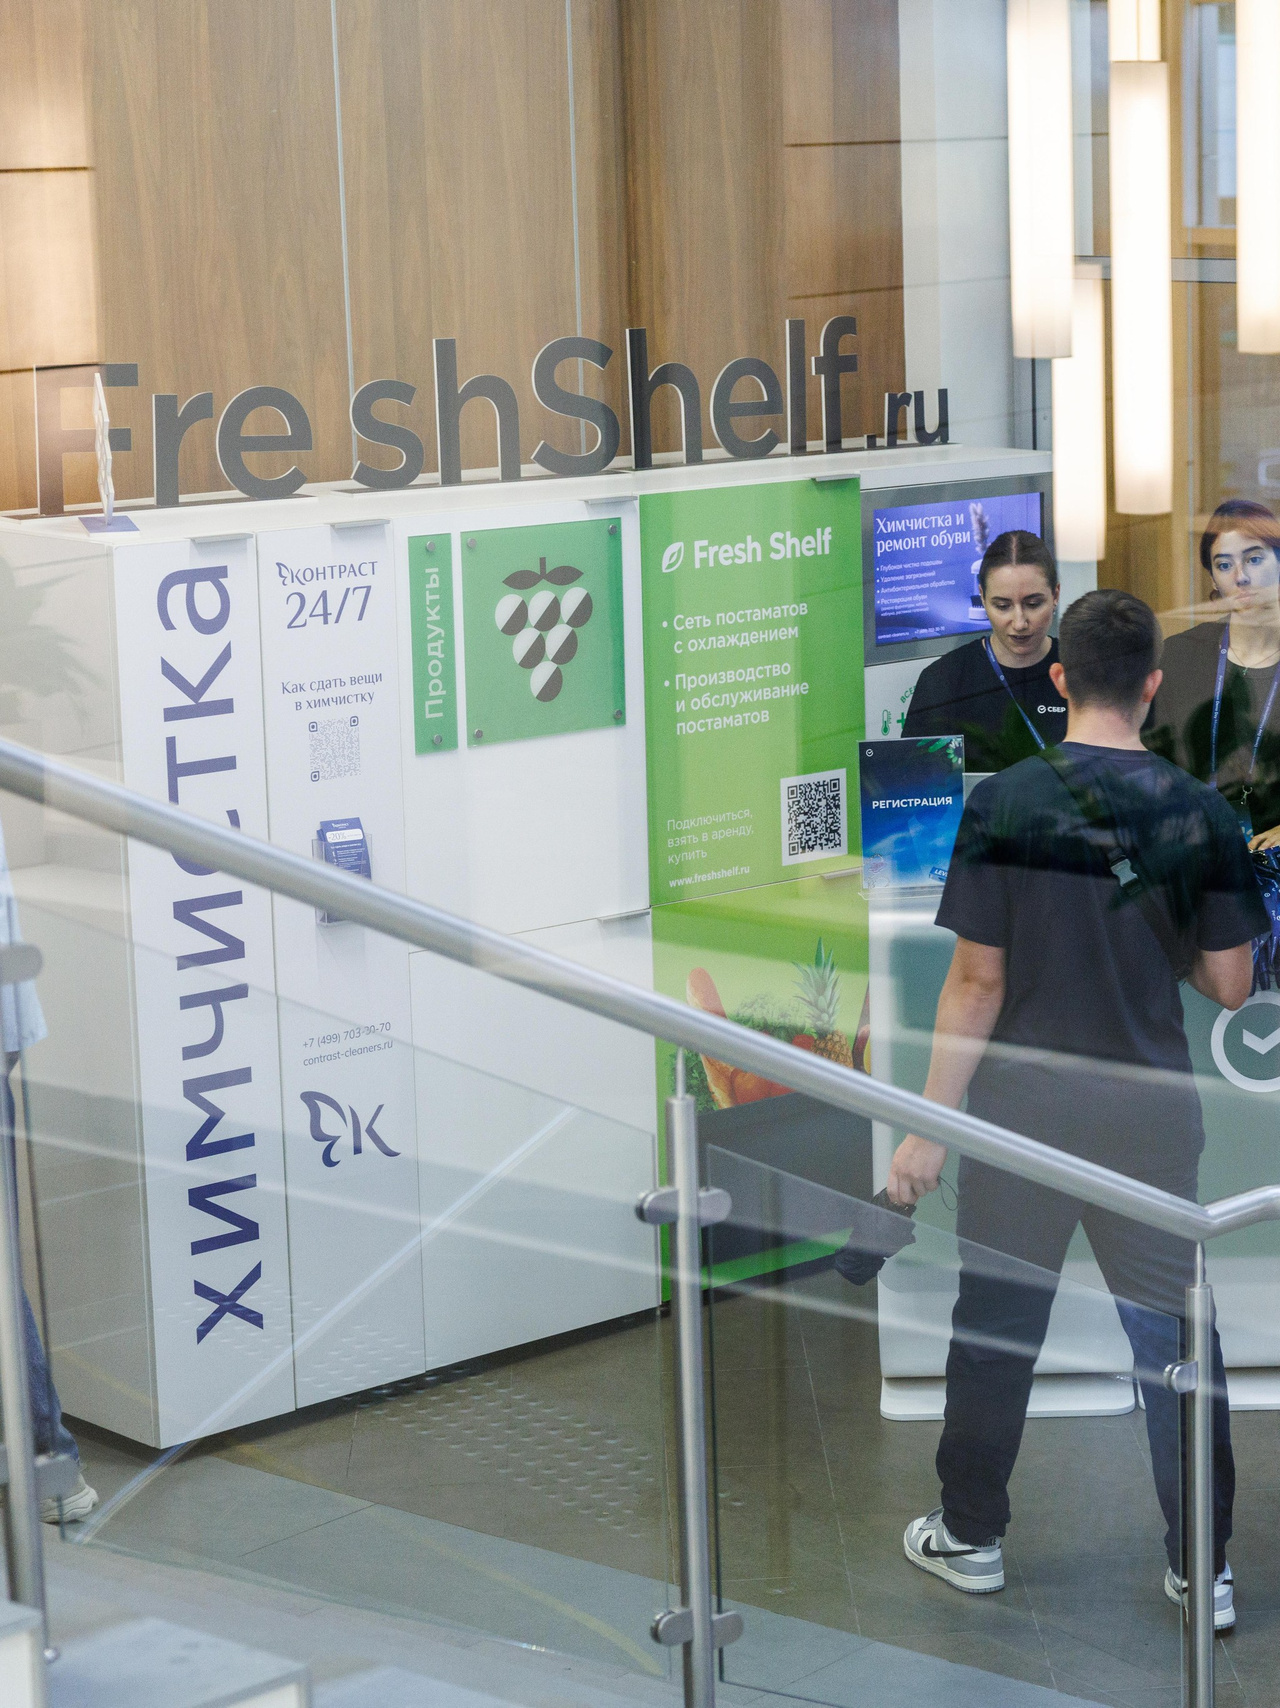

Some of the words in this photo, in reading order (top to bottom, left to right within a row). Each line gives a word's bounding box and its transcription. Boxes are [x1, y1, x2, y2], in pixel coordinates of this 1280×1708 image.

[876, 514, 952, 534] Химчистка
[956, 513, 965, 526] и
[693, 534, 762, 569] Fresh
[769, 526, 832, 560] Shelf
[876, 535, 927, 557] ремонт
[930, 529, 971, 550] обуви
[285, 585, 372, 630] 24/7
[673, 614, 711, 631] Сеть
[716, 601, 809, 626] постаматов
[425, 567, 446, 719] Продукты
[673, 640, 683, 654] с
[688, 625, 799, 652] охлаждением
[281, 681, 306, 695] Как
[309, 675, 346, 692] сдать
[349, 671, 383, 687] вещи
[675, 661, 791, 692] Производство
[295, 700, 302, 711] в
[306, 690, 375, 710] химчистку
[676, 699, 685, 713] и
[690, 680, 810, 710] обслуживание
[676, 708, 770, 736] постаматов
[872, 796, 953, 810] РЕГИСТРАЦИЯ
[667, 807, 753, 832] Подключиться,
[667, 831, 699, 848] взять
[701, 830, 709, 842] в
[711, 823, 754, 845] аренду,
[667, 848, 708, 867] купить
[668, 865, 750, 888] www.freshshelf.ru
[303, 1037, 314, 1048] +7
[317, 1032, 341, 1048] (499)
[343, 1021, 392, 1041] 703-30-70
[303, 1040, 394, 1067] contrast-cleaners.ru
